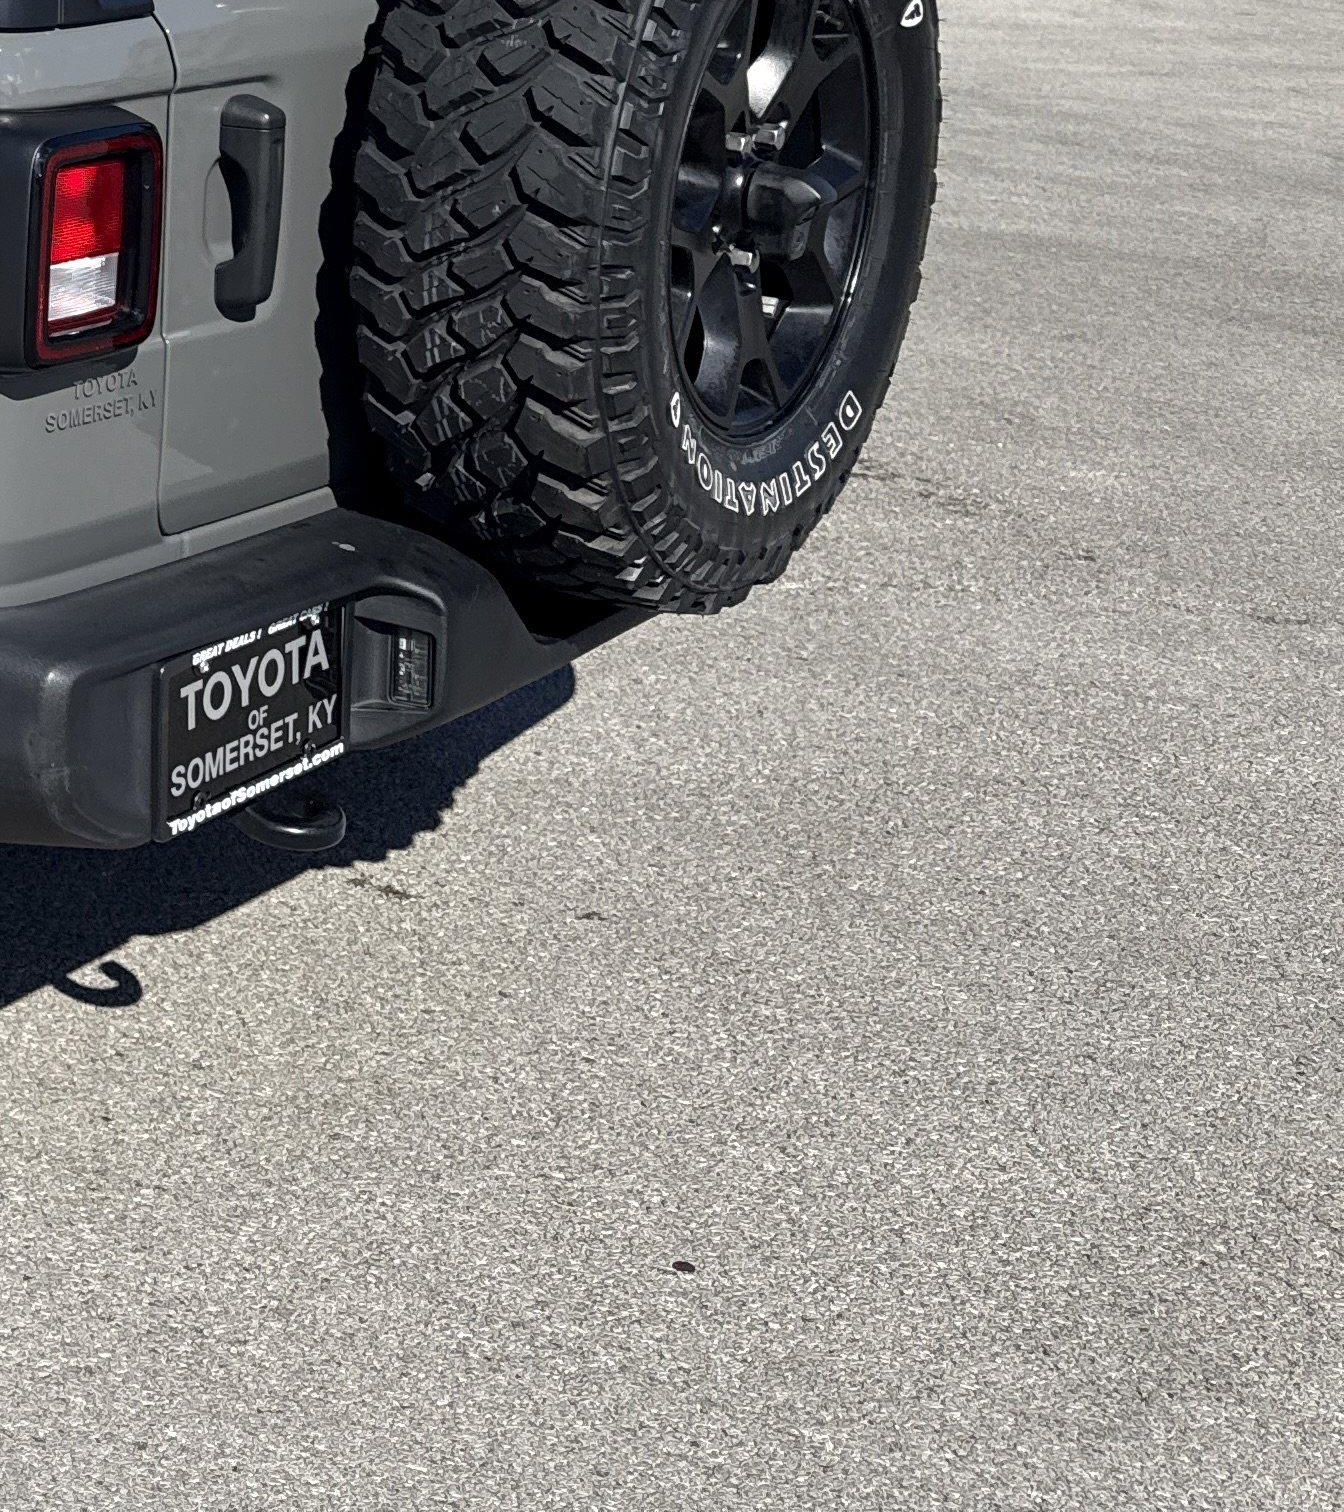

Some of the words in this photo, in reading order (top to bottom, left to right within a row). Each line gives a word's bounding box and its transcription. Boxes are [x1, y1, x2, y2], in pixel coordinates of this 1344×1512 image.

[45, 396, 134, 433] SOMERSET,
[73, 369, 138, 400] TOYOTA
[682, 390, 862, 516] DESTINATION
[180, 629, 330, 731] TOYOTA
[192, 642, 225, 666] GREAT
[170, 712, 301, 797] SOMERSET,
[308, 693, 338, 733] KY
[248, 705, 269, 730] OF
[167, 741, 345, 835] ToyotaofSomerset.com
